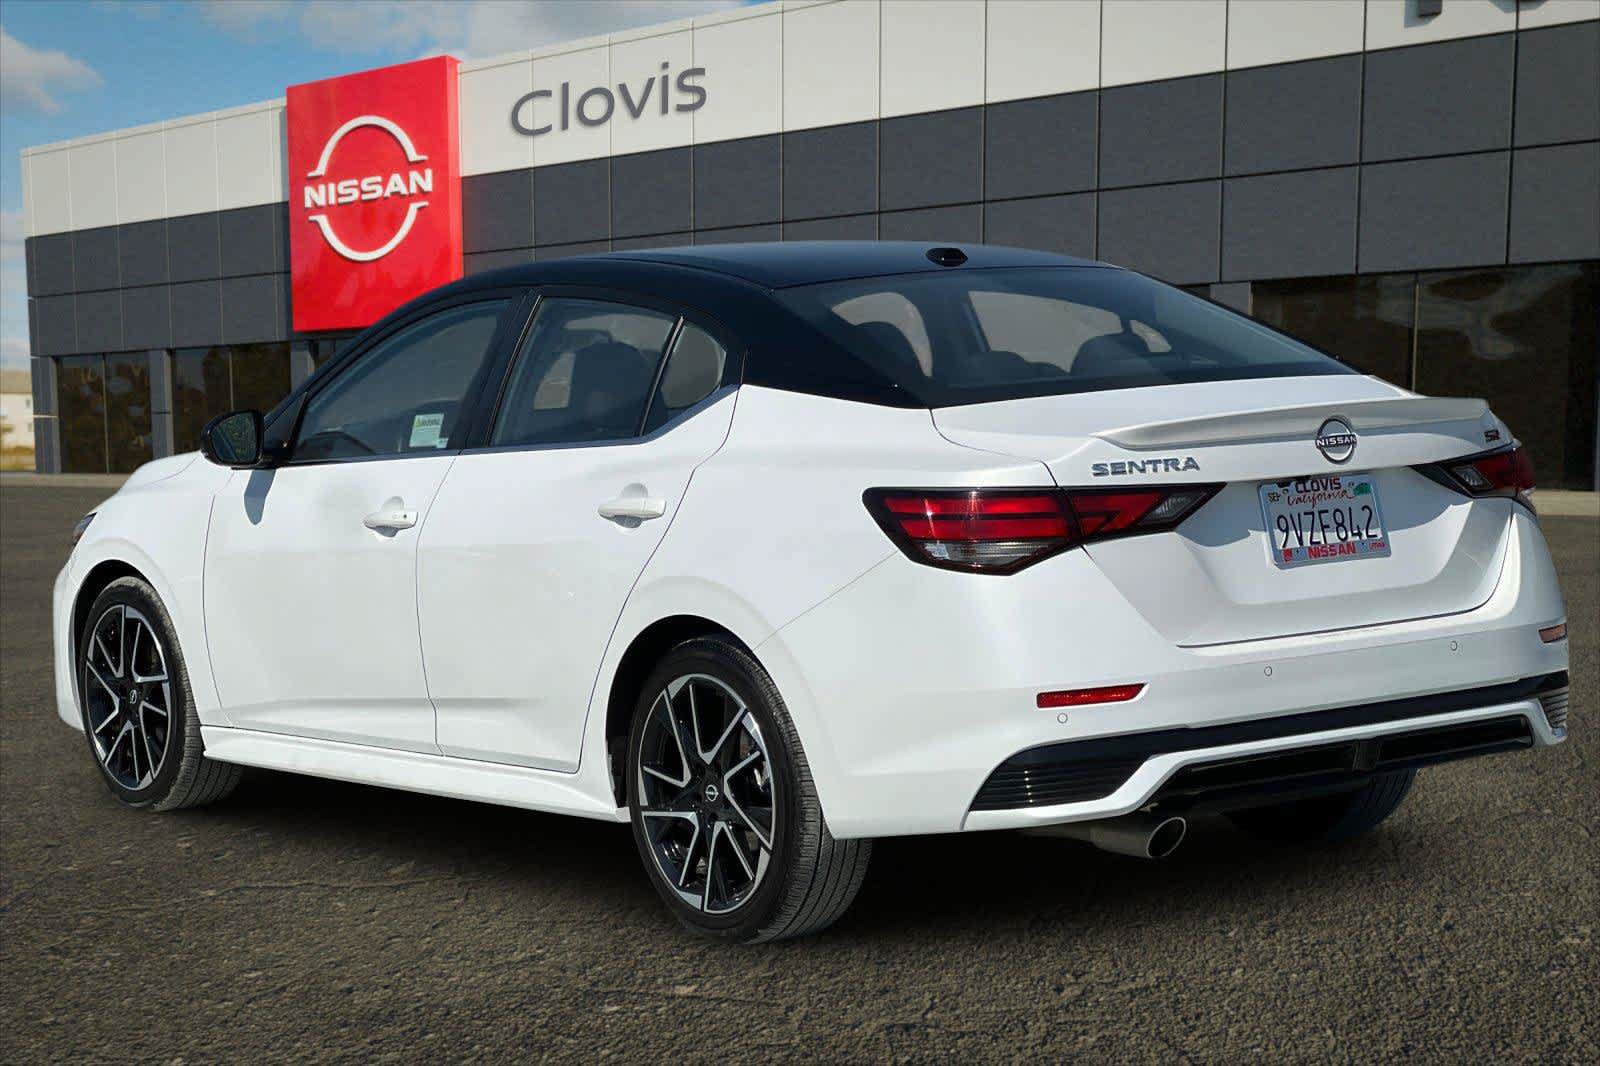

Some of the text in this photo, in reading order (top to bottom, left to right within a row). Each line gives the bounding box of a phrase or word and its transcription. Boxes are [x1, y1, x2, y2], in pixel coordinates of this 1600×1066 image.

[511, 62, 707, 136] Clovis
[304, 169, 433, 208] NISSAN
[1316, 435, 1357, 446] NISSAN
[1092, 457, 1200, 476] SENTRA
[1295, 477, 1341, 493] CLOVIS
[1277, 505, 1377, 549] 9VZF842
[1308, 542, 1356, 559] NISSAN
